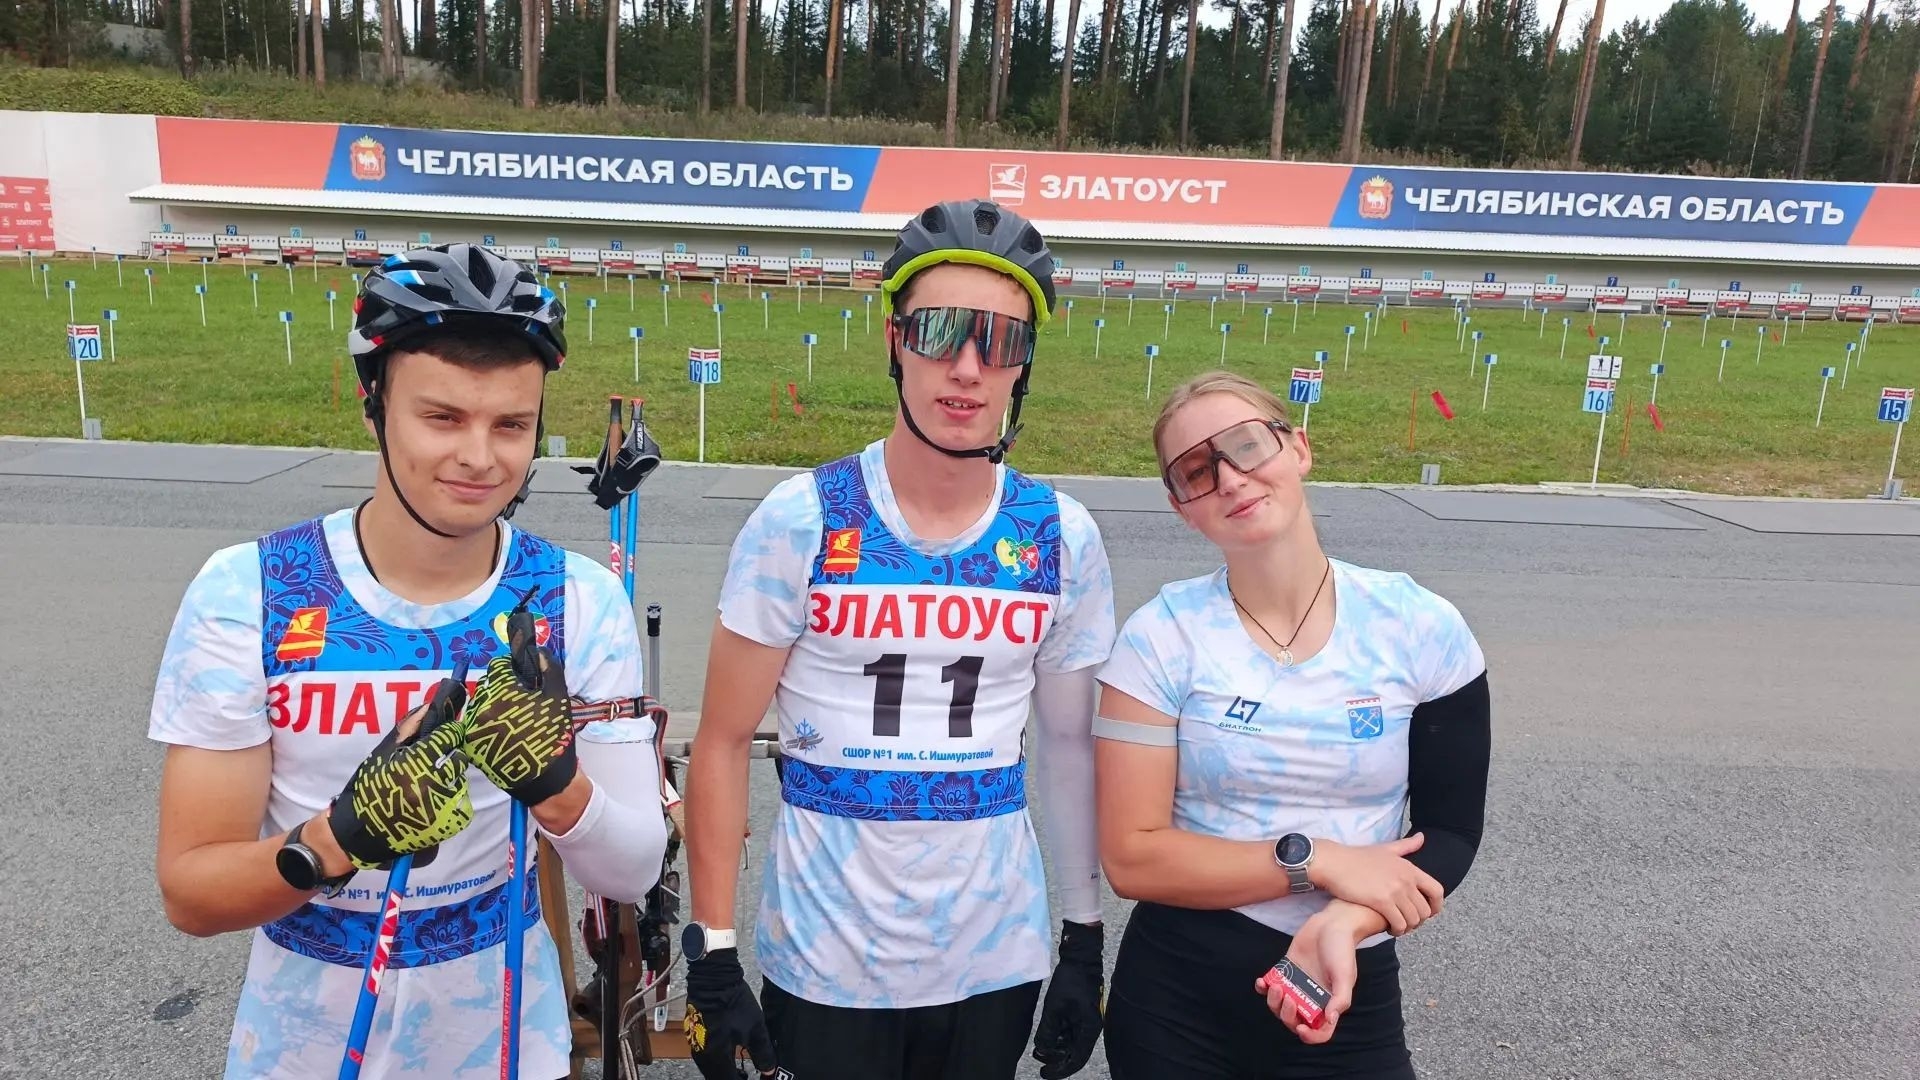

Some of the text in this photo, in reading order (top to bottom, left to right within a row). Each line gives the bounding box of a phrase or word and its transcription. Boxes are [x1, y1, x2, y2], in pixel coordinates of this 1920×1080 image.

[397, 148, 854, 192] ЧЕЛЯБИНСКАЯ ОБЛАСТЬ
[1039, 174, 1228, 204] ЗЛАТОУСТ
[1404, 187, 1845, 226] ЧЕЛЯБИНСКАЯ ОБЛАСТЬ
[78, 337, 99, 359] 20
[690, 361, 701, 382] 19
[704, 361, 719, 382] 18
[1293, 380, 1309, 402] 17
[1588, 390, 1604, 411] 16
[1883, 399, 1904, 421] 15
[809, 592, 1049, 644] ЗЛАТОУСТ
[863, 653, 985, 738] 11
[842, 747, 871, 759] СШОР
[897, 752, 917, 761] им.
[919, 750, 928, 761] С.
[929, 748, 994, 763] Ишмуратовой
[416, 868, 497, 898] Ишмуратовой
